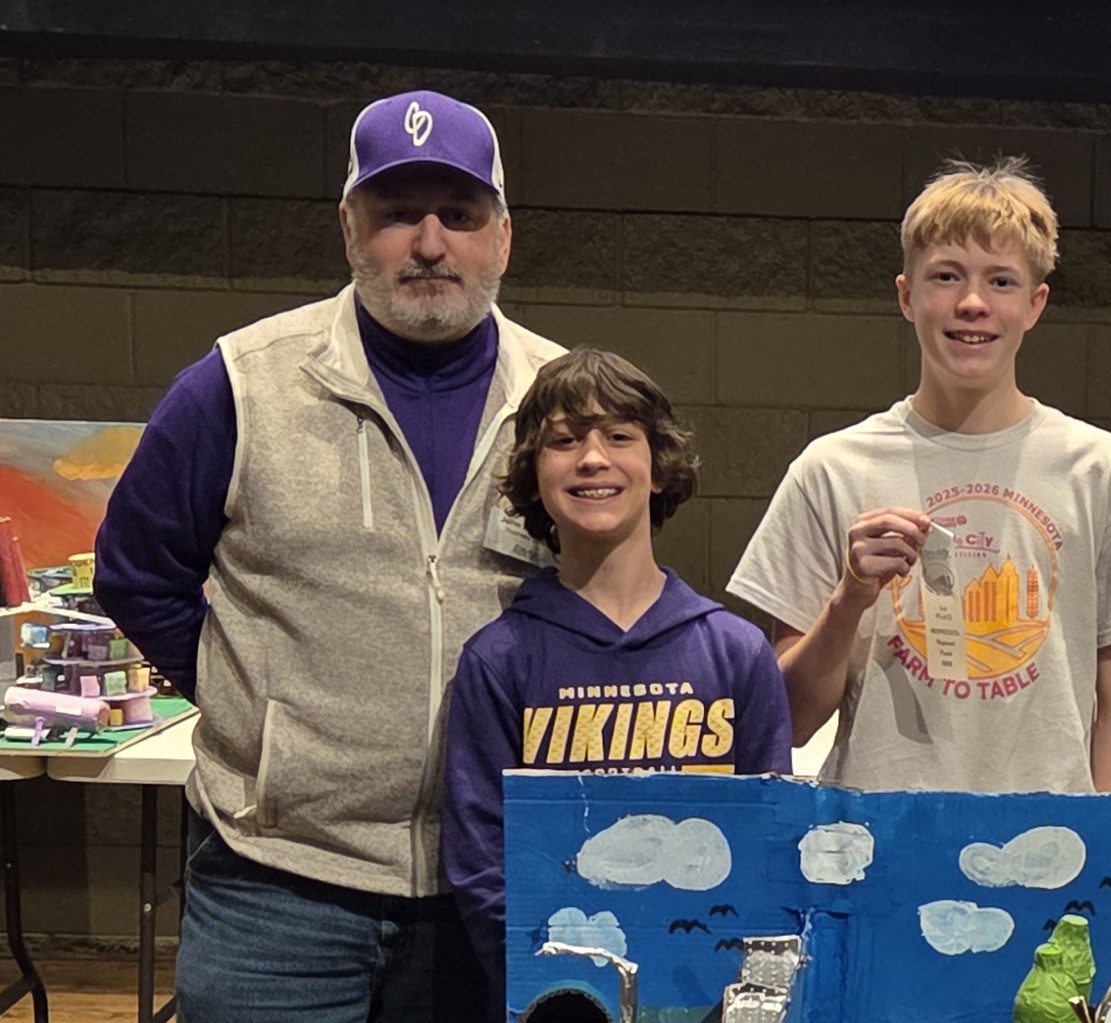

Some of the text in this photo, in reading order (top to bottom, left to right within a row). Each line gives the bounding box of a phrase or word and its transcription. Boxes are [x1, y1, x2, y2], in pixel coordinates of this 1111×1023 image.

[926, 483, 1064, 552] 2025-2026 MINNESOTA
[558, 681, 695, 700] MINNESOTA
[886, 634, 1041, 700] FARM TO TABLE
[522, 698, 735, 764] VIKINGS
